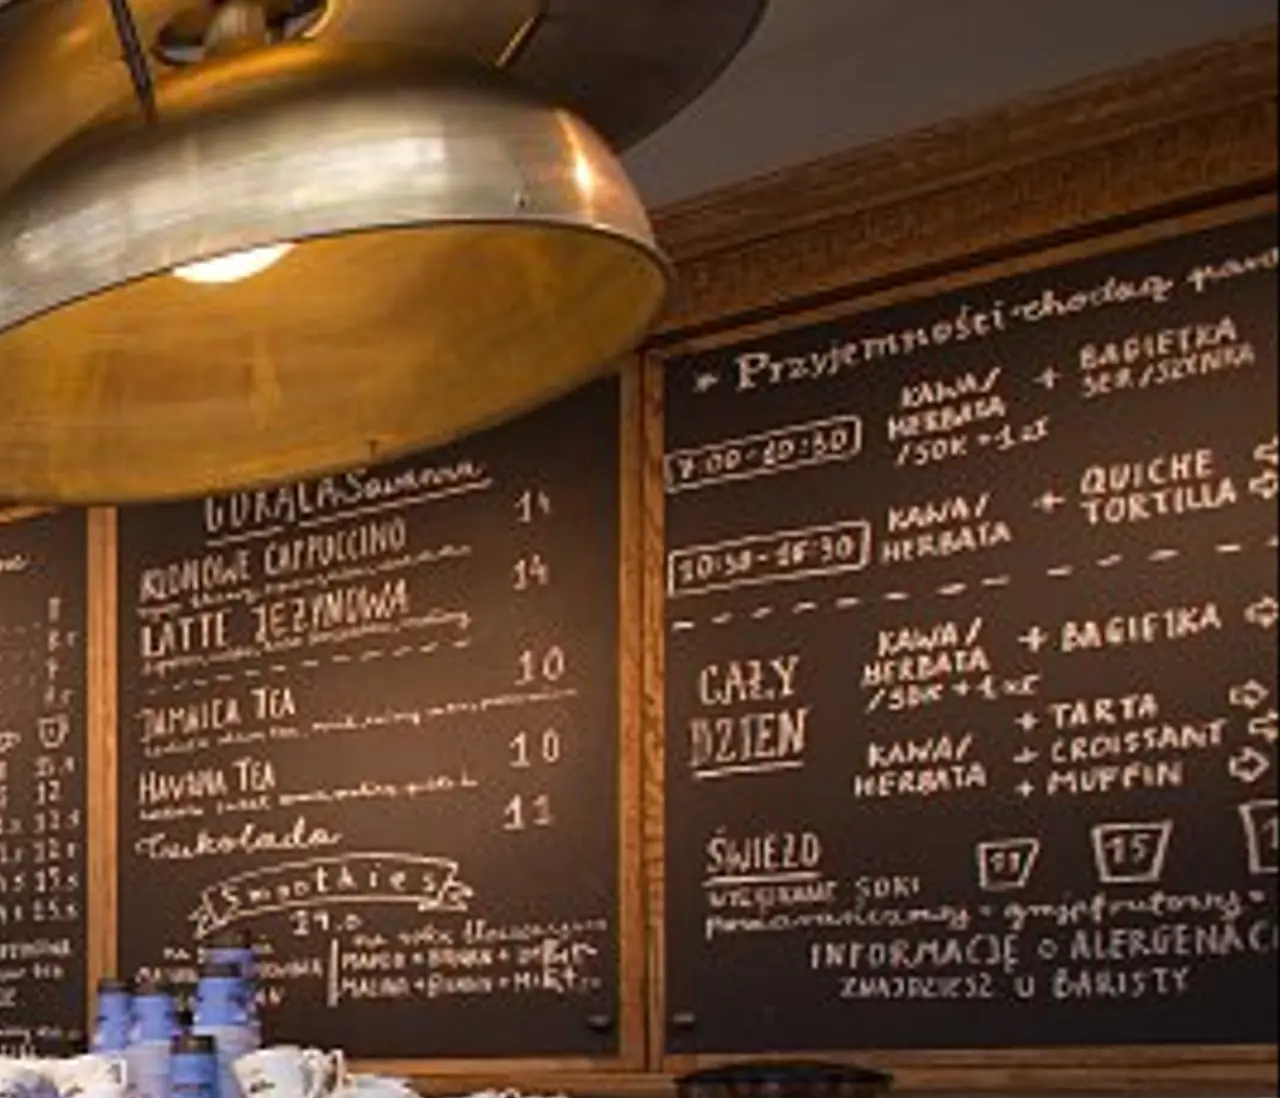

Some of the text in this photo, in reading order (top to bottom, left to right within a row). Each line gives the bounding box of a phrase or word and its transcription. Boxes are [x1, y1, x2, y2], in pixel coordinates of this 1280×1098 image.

[1080, 449, 1215, 496] QUICHE
[1080, 477, 1237, 525] TORTILLA
[263, 516, 406, 577] CAPPUCCINO
[512, 554, 549, 591] 14
[143, 610, 227, 658] LATTE
[514, 646, 565, 687] 10
[250, 685, 296, 720] TEA
[1050, 692, 1158, 730] TARTA
[508, 726, 561, 769] 10
[1051, 717, 1227, 764] CROISSANT
[232, 755, 276, 793] TEA
[1046, 760, 1183, 796] MUFFIN
[1053, 965, 1190, 999] BARISTY
